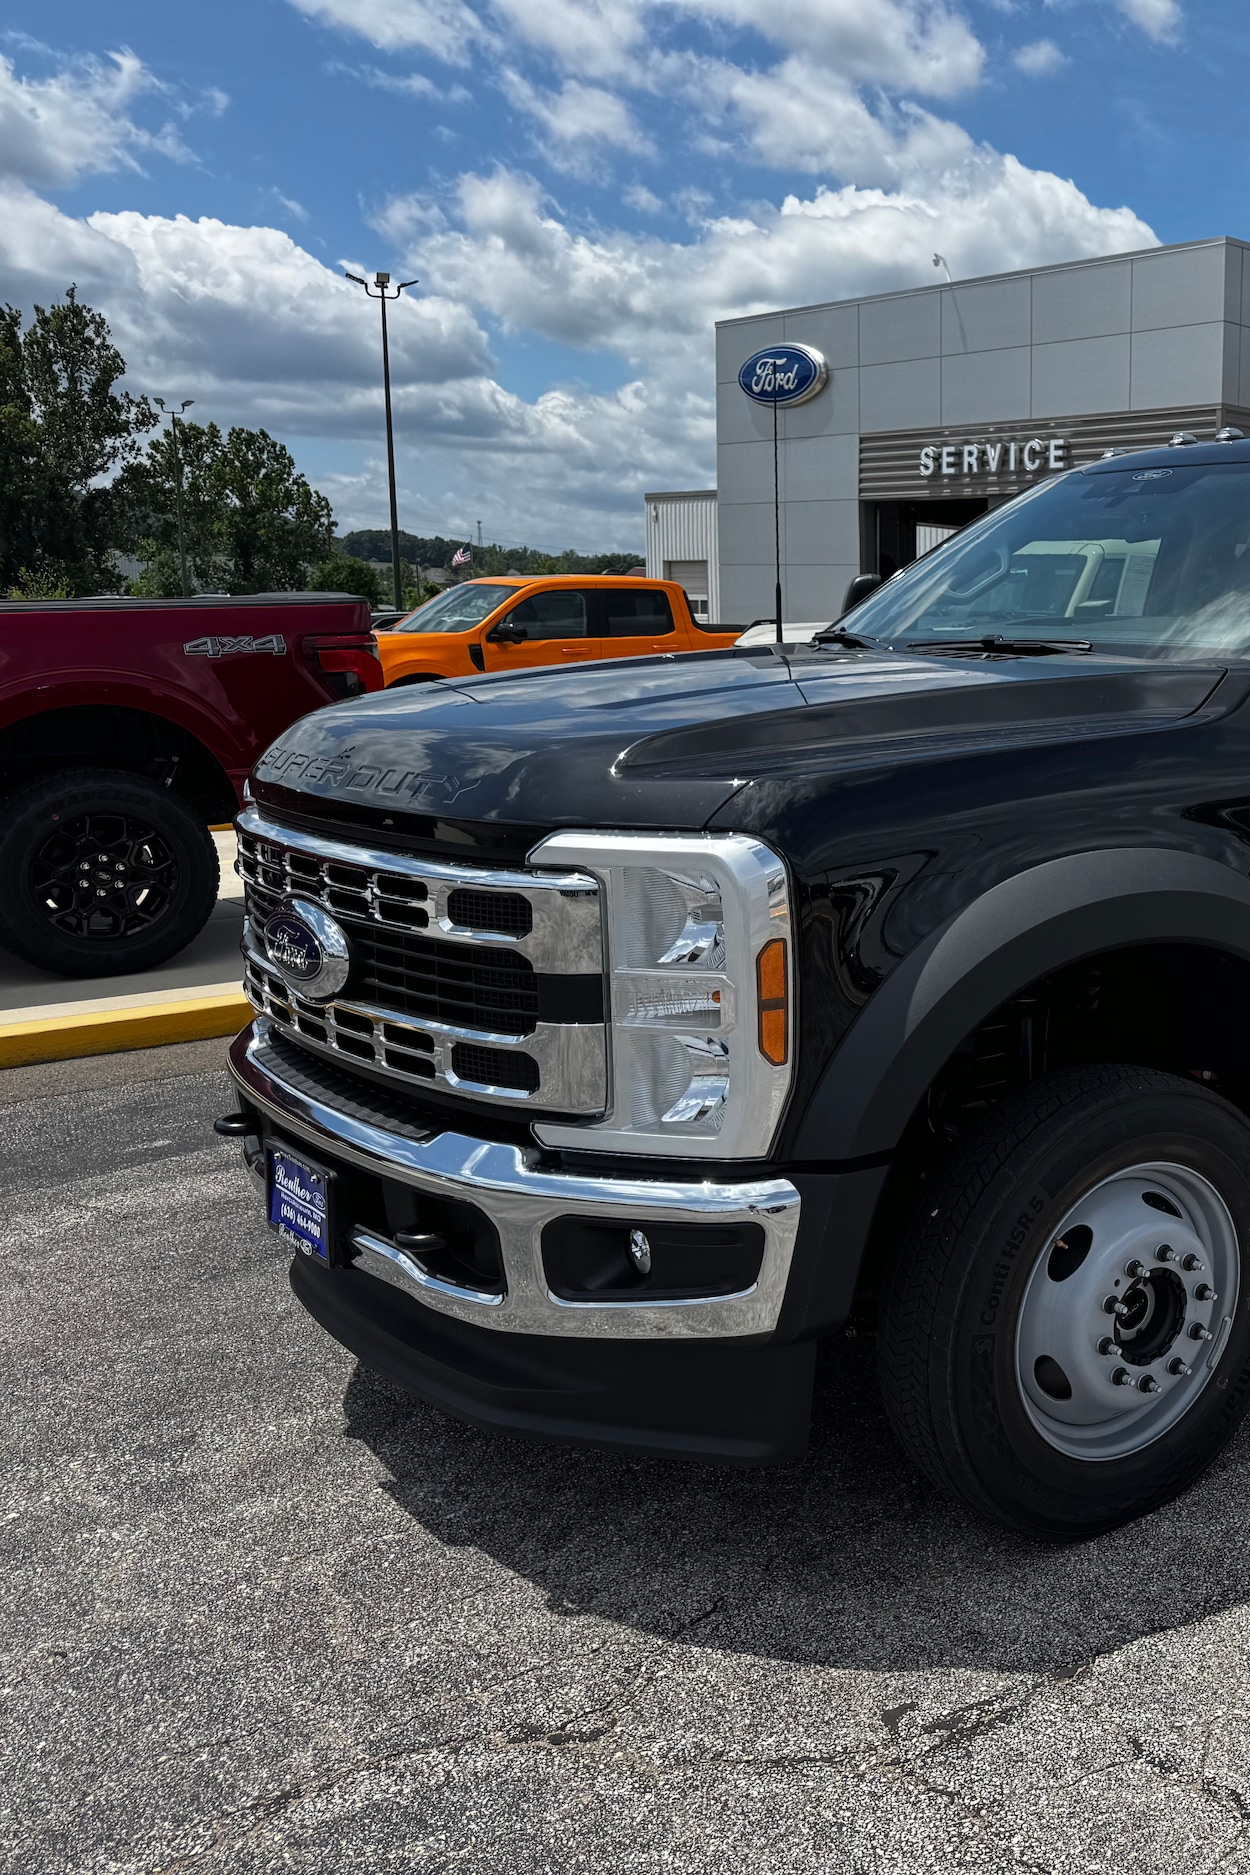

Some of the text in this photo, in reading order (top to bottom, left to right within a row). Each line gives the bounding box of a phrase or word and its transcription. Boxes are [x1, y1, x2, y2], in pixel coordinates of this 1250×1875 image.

[752, 357, 799, 393] Ford
[919, 438, 1065, 477] SERVICE
[258, 747, 482, 804] SUPER DUTY
[274, 925, 309, 971] Ford
[275, 1164, 312, 1202] Reuther
[981, 1195, 1045, 1326] Conti HSR 5
